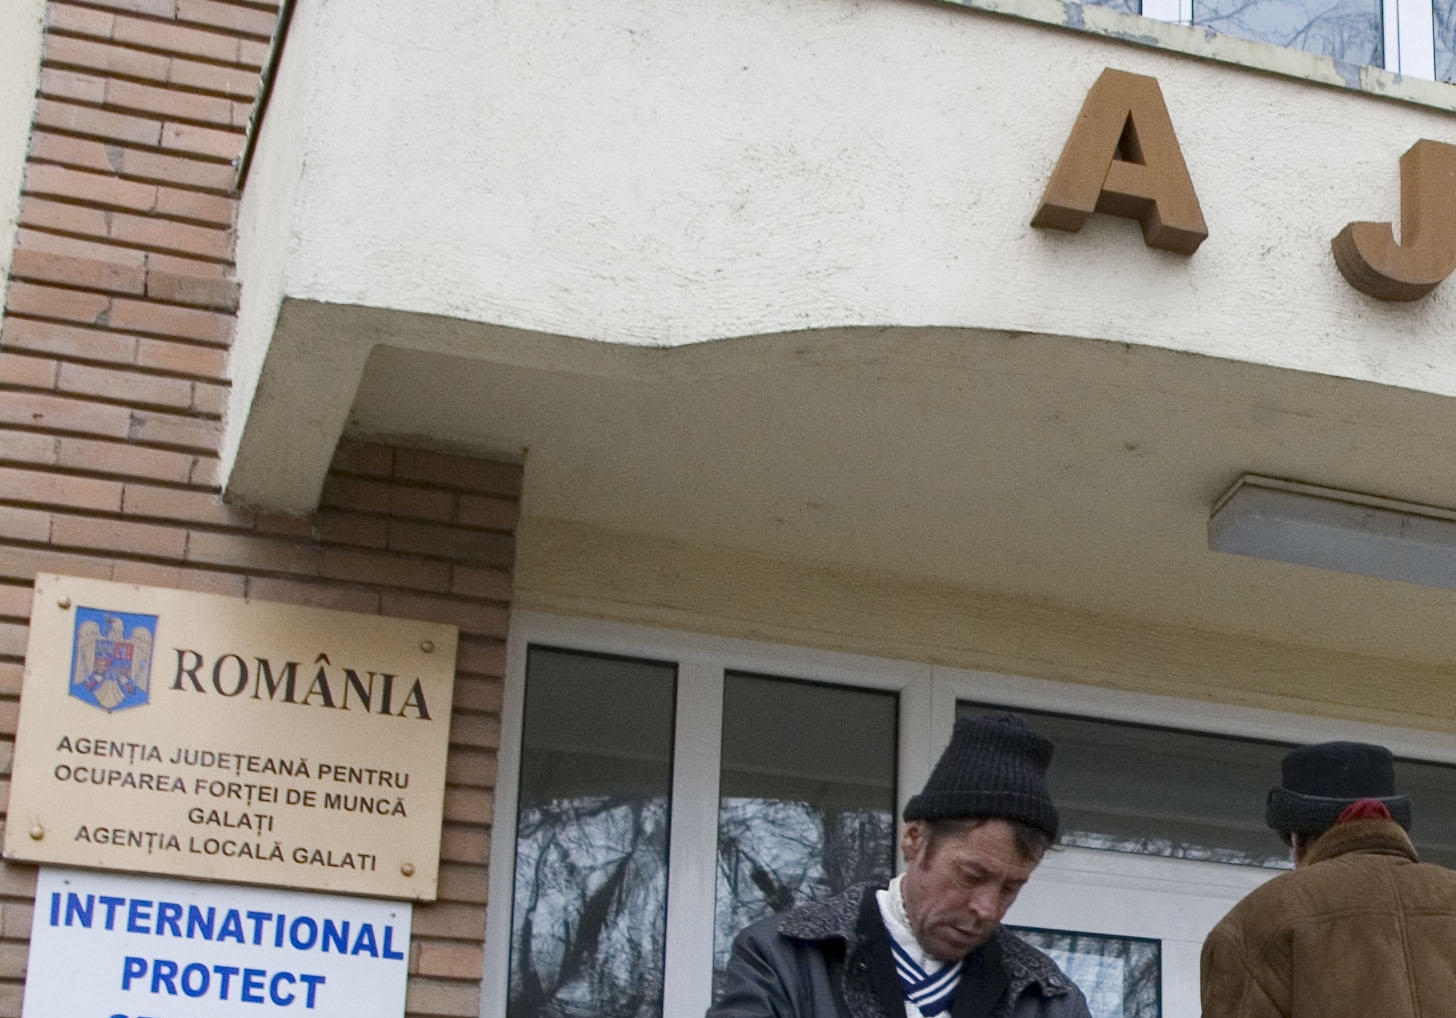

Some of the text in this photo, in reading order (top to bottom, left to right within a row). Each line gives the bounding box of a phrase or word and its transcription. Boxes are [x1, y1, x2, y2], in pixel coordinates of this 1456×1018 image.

[169, 648, 433, 721] ROMÂNIA
[57, 735, 410, 789] AGENȚIA JUDEȚEANĂ PENTRU
[54, 764, 407, 817] OCUPAREA FORȚEI DE MUNCĂ
[188, 807, 273, 835] GALAȚI
[74, 825, 377, 871] AGENȚIA LOCALĂ GALATI
[49, 892, 404, 960] INTERNATIONAL
[121, 956, 326, 1009] PROTECT
